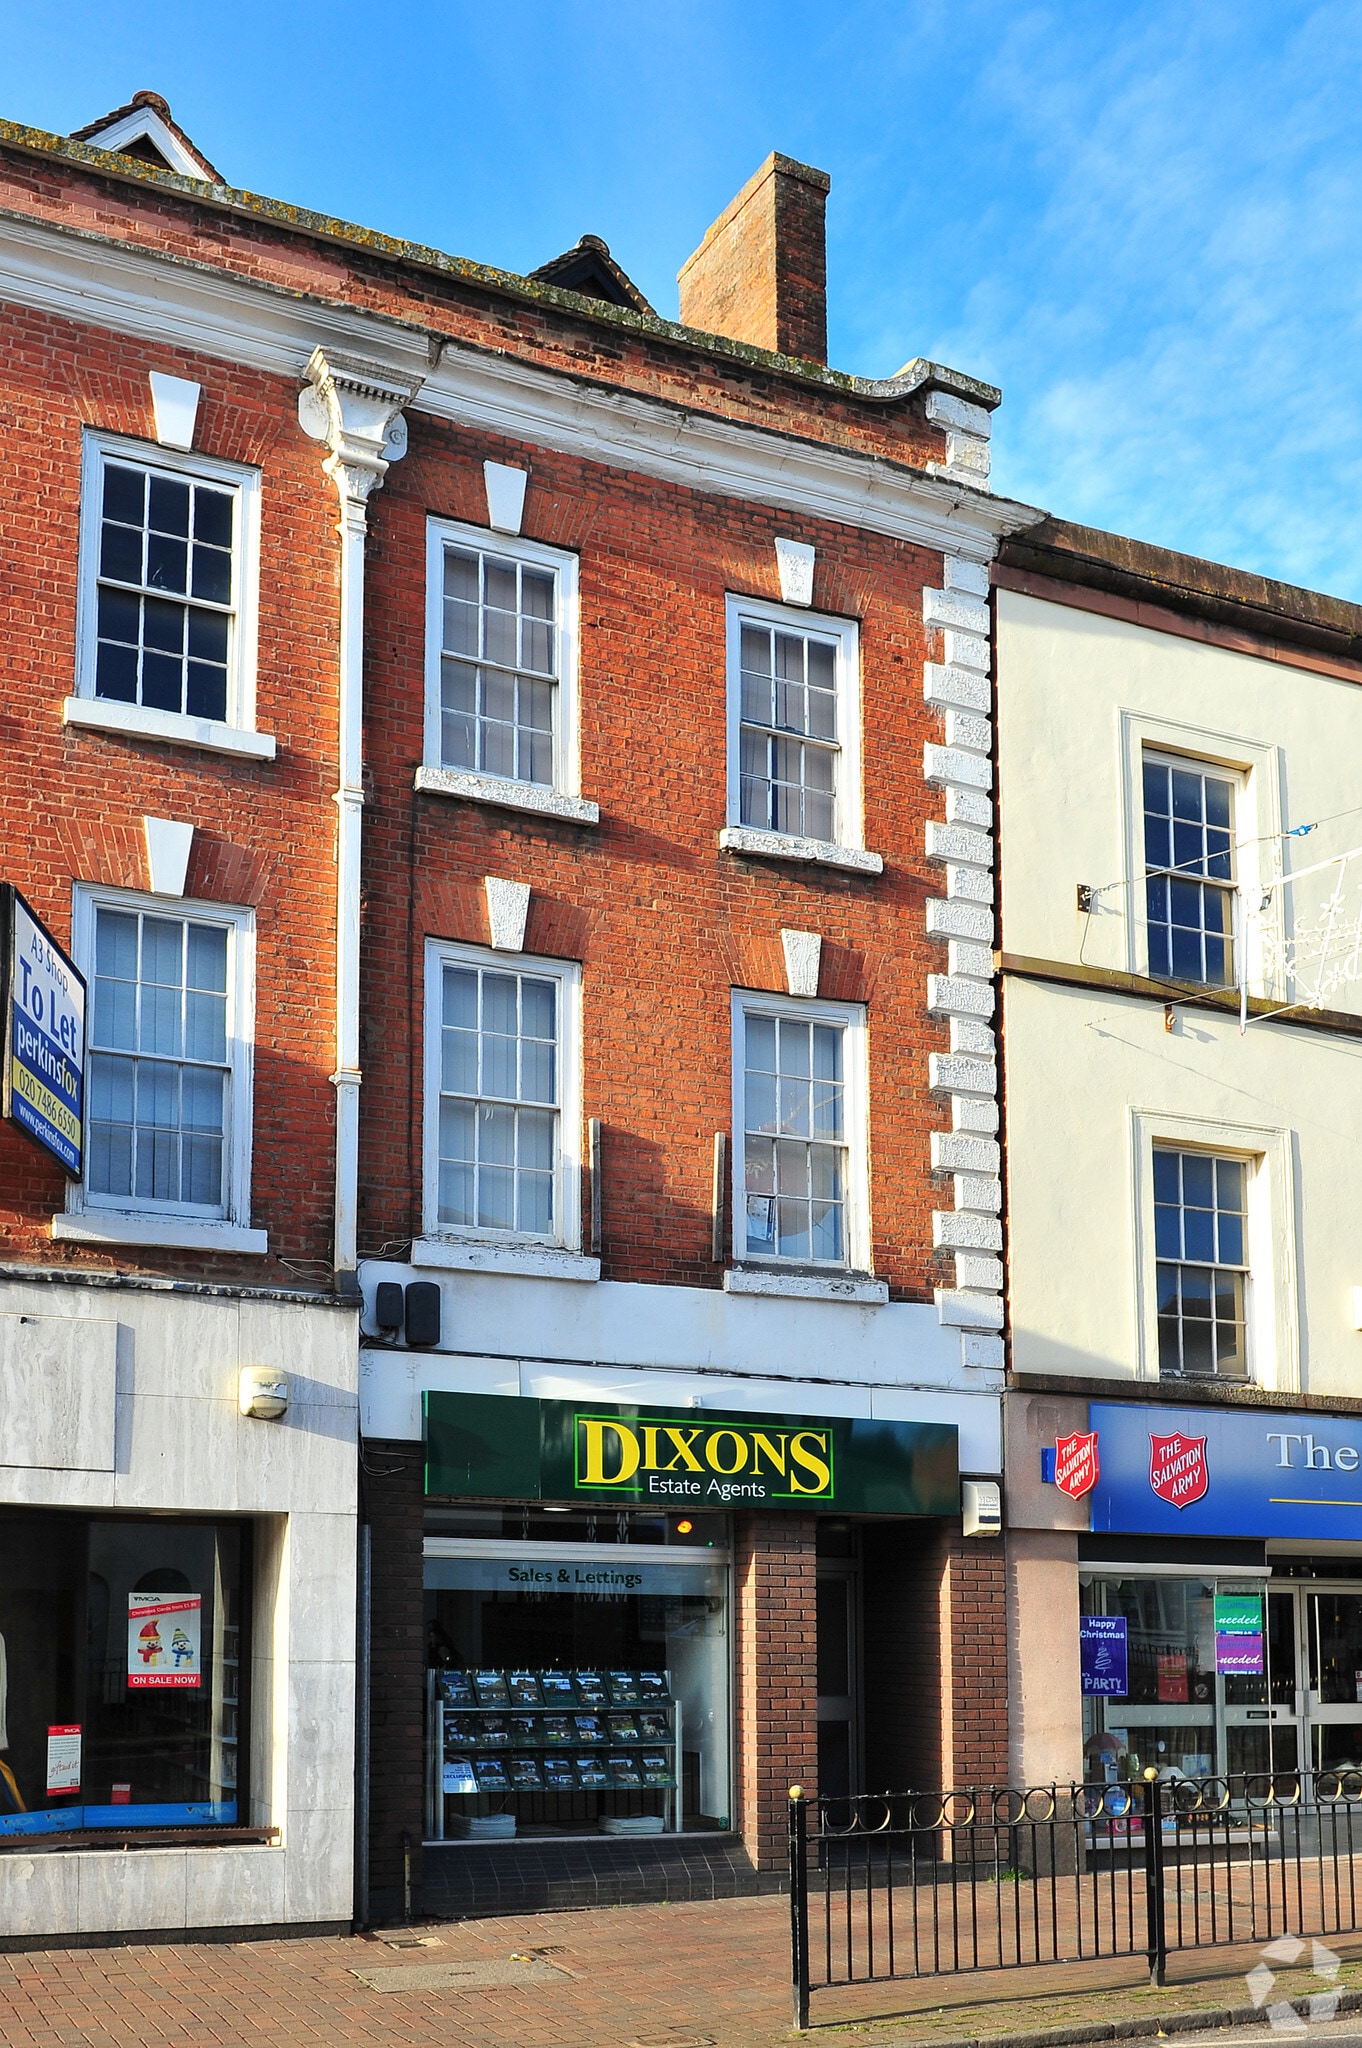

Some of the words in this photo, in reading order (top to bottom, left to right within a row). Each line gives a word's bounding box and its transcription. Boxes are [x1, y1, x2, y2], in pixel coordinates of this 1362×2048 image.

[31, 932, 44, 964] A3
[46, 948, 69, 997] Shop
[20, 954, 44, 1022] To
[50, 988, 77, 1059] Let
[17, 1020, 78, 1102] perkinsfox
[19, 1068, 35, 1101] 020
[36, 1084, 57, 1122] 7486
[57, 1106, 76, 1140] 6550
[18, 1102, 76, 1165] www.perkinsfox.com
[578, 1419, 830, 1494] DIXONS
[1057, 1440, 1091, 1485] SALVATION
[1061, 1438, 1078, 1462] THE
[1152, 1443, 1202, 1489] SALVATION
[1159, 1438, 1182, 1463] THE
[1266, 1432, 1359, 1471] The
[649, 1475, 701, 1495] Estate
[706, 1478, 766, 1500] Agents
[1069, 1459, 1090, 1491] ARMY
[1171, 1465, 1201, 1499] ARMY
[508, 1567, 553, 1582] Sales
[557, 1568, 570, 1583] &
[575, 1569, 642, 1588] Lettings
[1080, 1630, 1125, 1639] Christmas
[1088, 1619, 1116, 1629] Happy
[1218, 1614, 1260, 1625] needed
[1220, 1654, 1261, 1664] needed
[132, 1676, 146, 1684] ON
[148, 1676, 172, 1684] SALE
[174, 1676, 197, 1684] NOW
[1084, 1677, 1122, 1691] PARTY
